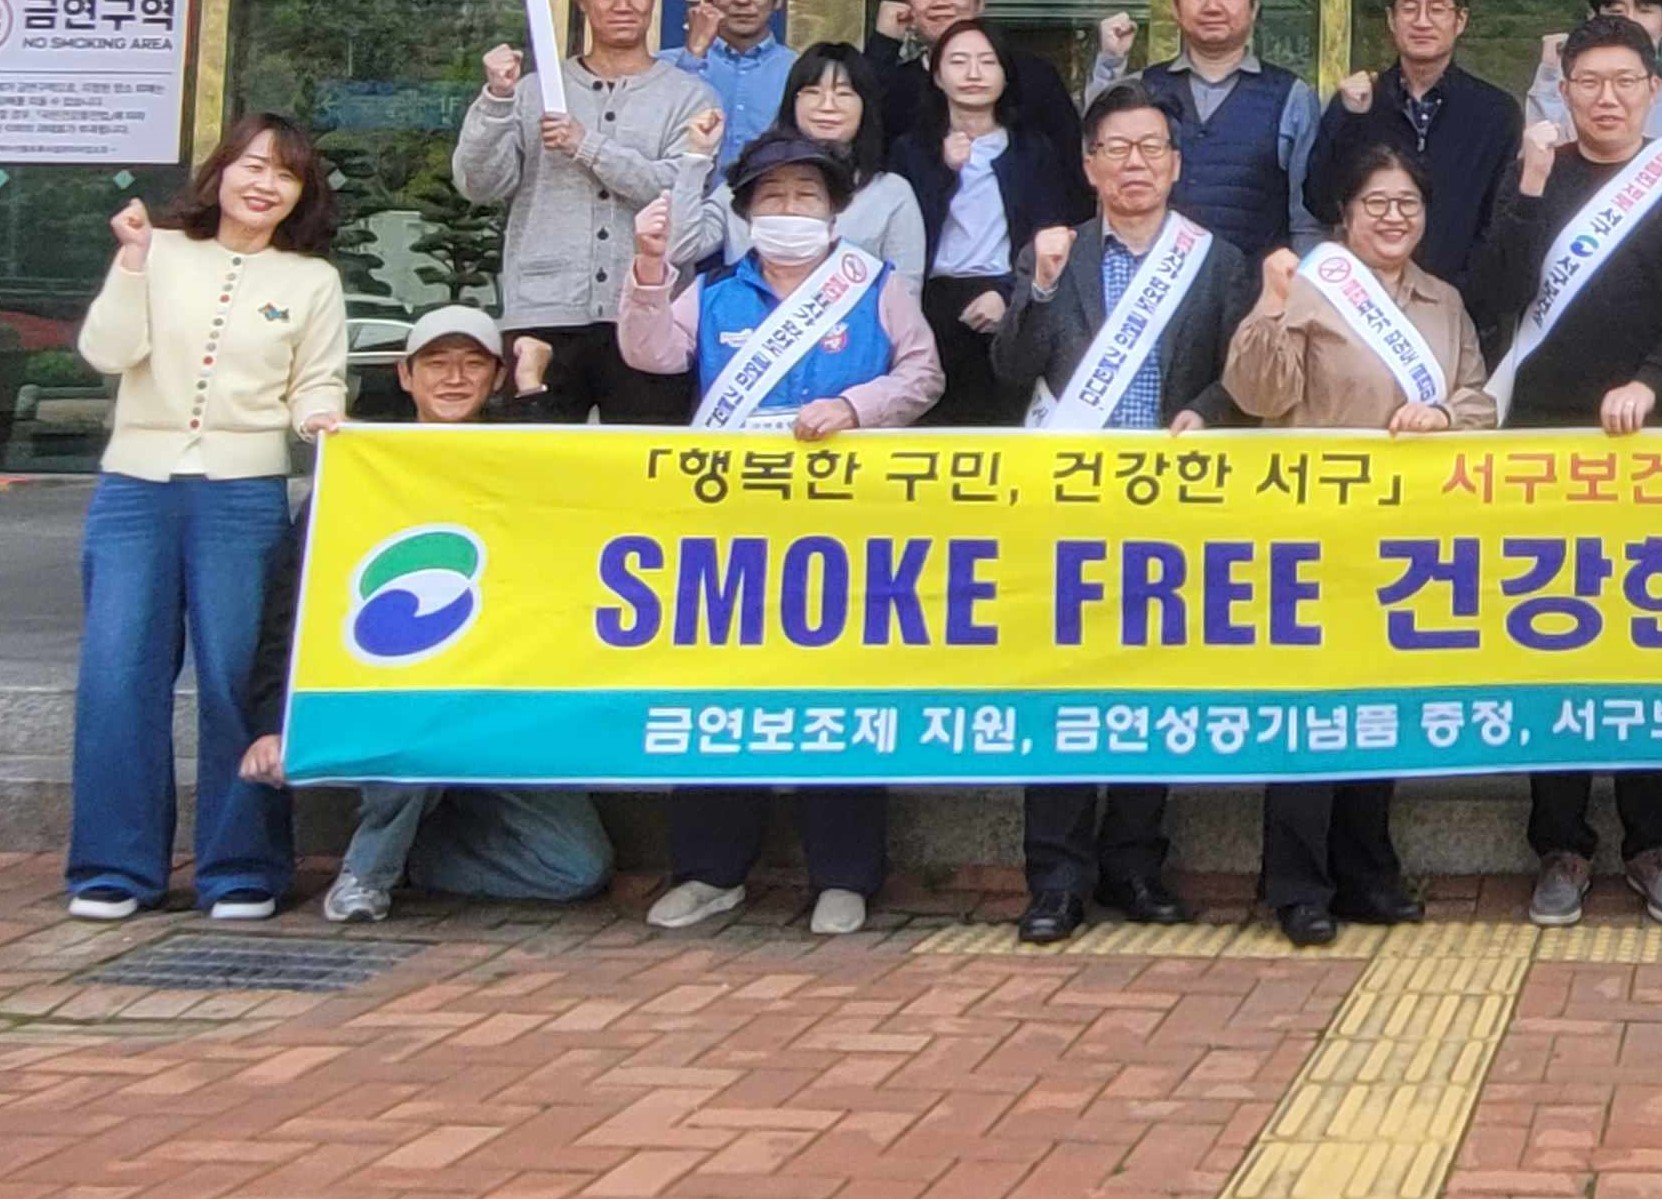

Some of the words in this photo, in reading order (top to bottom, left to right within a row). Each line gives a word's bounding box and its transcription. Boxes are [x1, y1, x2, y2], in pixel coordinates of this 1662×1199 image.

[24, 37, 47, 49] NO
[51, 37, 126, 50] SMOKING
[129, 37, 173, 50] AREA
[1590, 208, 1622, 235] 서구
[885, 450, 1020, 506] 구민,
[1054, 450, 1231, 505] 건강한
[595, 535, 999, 648] SMOKE
[1055, 540, 1322, 647] FREE
[643, 704, 897, 755] 금연보조제
[922, 705, 1031, 757] 지원,
[1054, 702, 1400, 754] 금연성공기념품
[1421, 699, 1531, 750] 증정,
